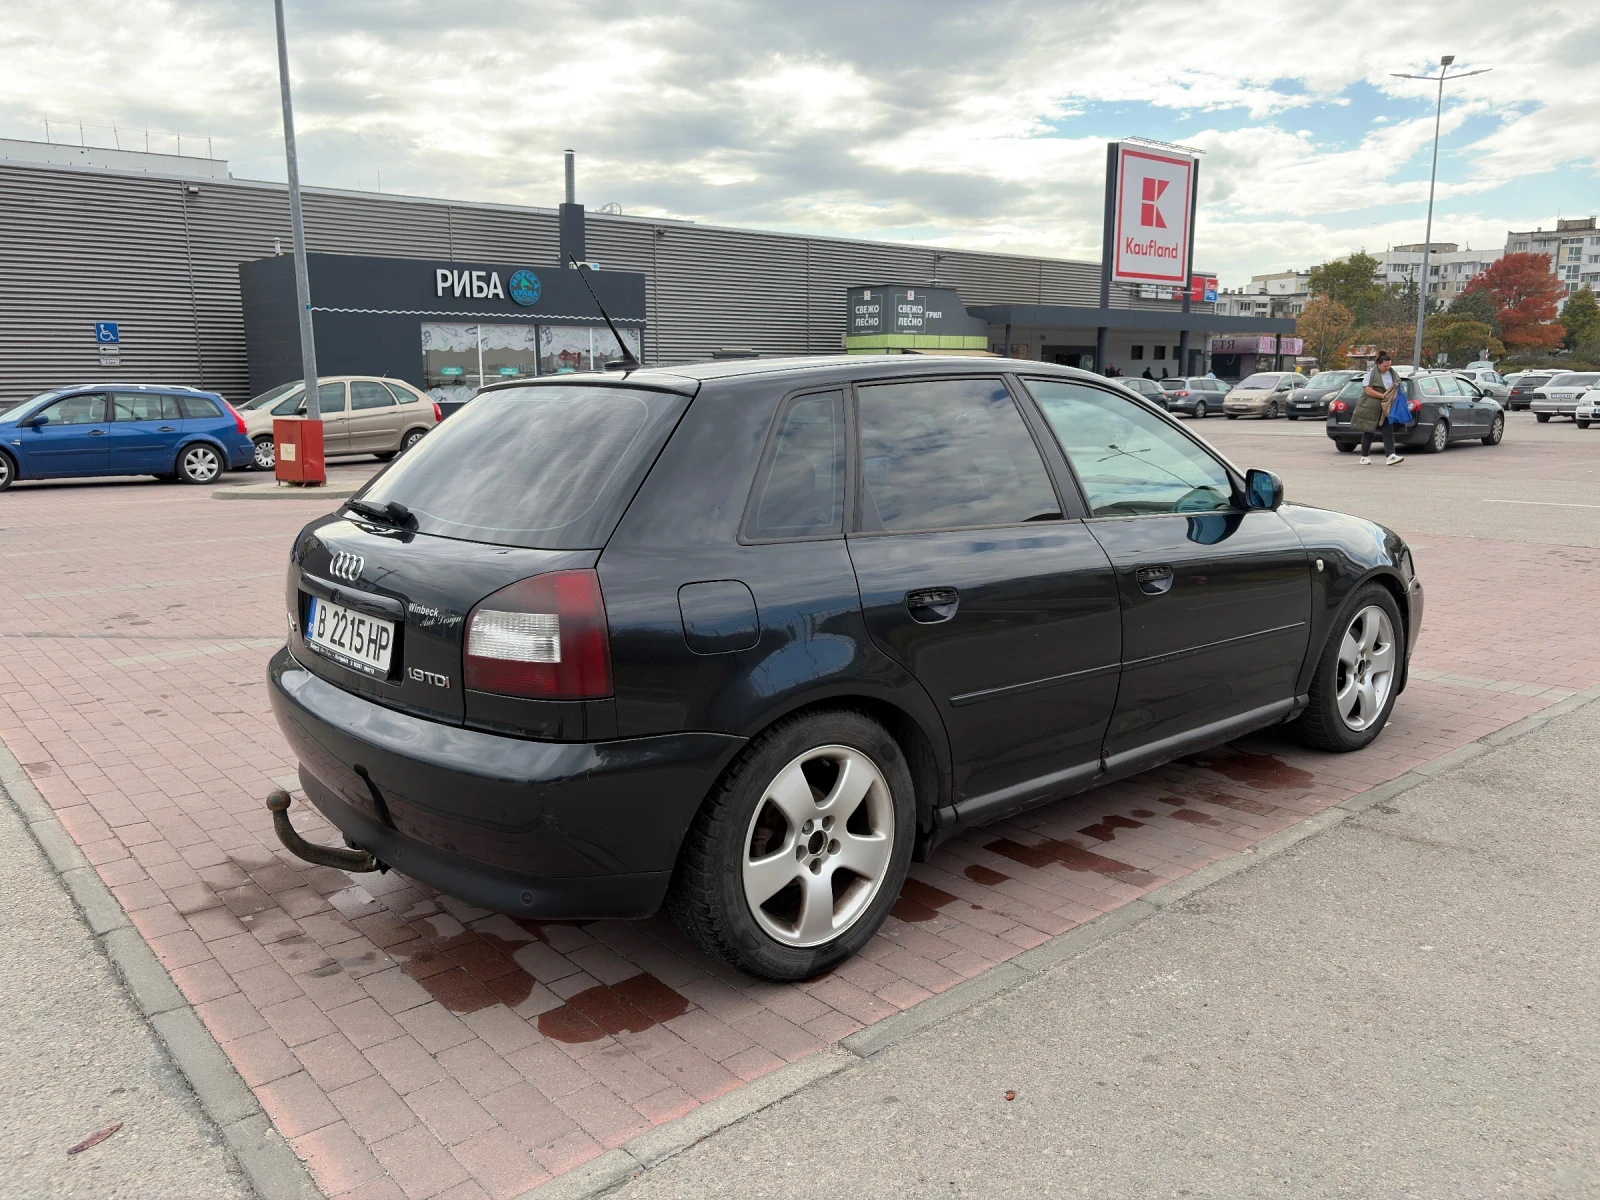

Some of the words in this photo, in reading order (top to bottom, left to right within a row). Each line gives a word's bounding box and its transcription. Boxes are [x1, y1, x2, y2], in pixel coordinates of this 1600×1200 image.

[1125, 237, 1179, 260] Kaufland
[435, 268, 505, 299] РИБА
[511, 271, 540, 289] МОРСКА
[855, 304, 880, 314] СВЕЖО
[898, 304, 923, 314] СВЕЖО
[926, 311, 942, 319] ГРИЛ
[855, 317, 879, 327] ЛЕСНО
[898, 317, 923, 326] ЛЕСНО
[408, 602, 439, 617] Winbeck
[317, 604, 327, 639] B
[330, 610, 366, 655] 2215
